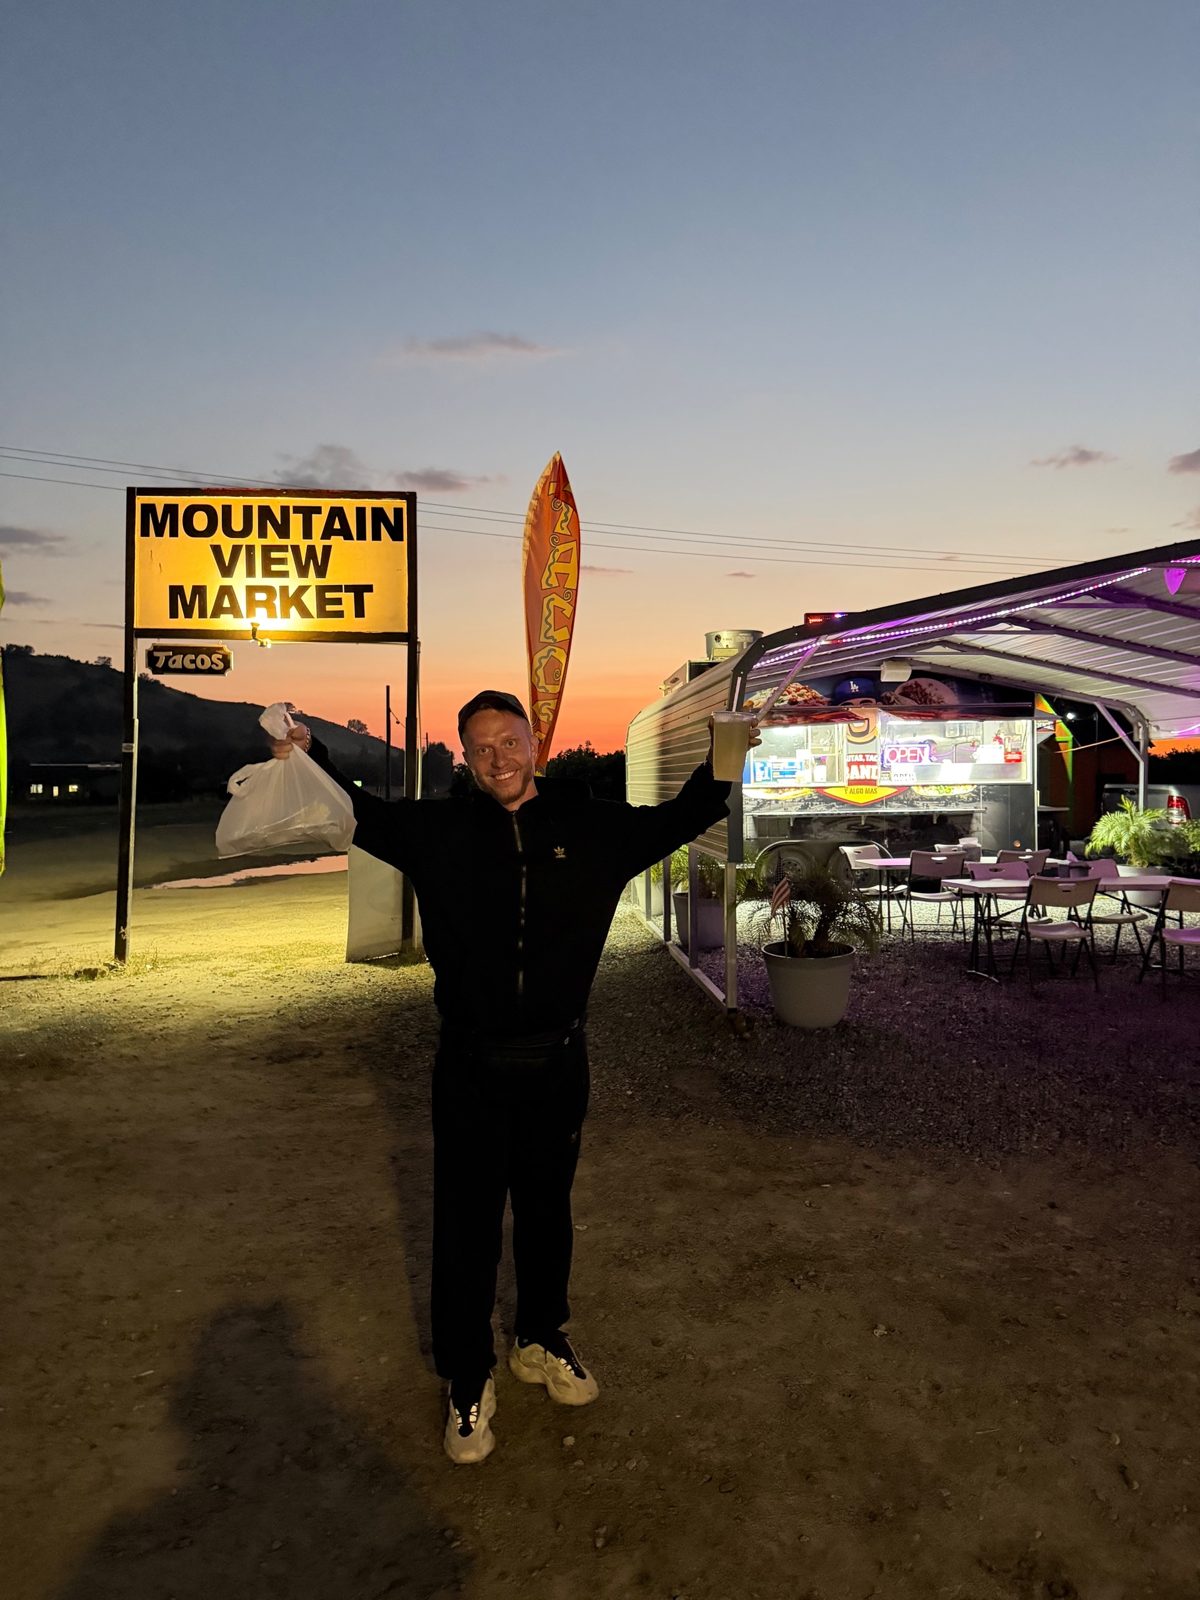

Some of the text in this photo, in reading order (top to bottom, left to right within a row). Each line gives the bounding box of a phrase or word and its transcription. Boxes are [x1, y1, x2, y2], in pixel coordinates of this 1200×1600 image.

[140, 503, 404, 542] MOUNTAIN
[210, 544, 332, 579] VIEW
[168, 584, 374, 619] MARKET
[888, 747, 926, 763] OPEN
